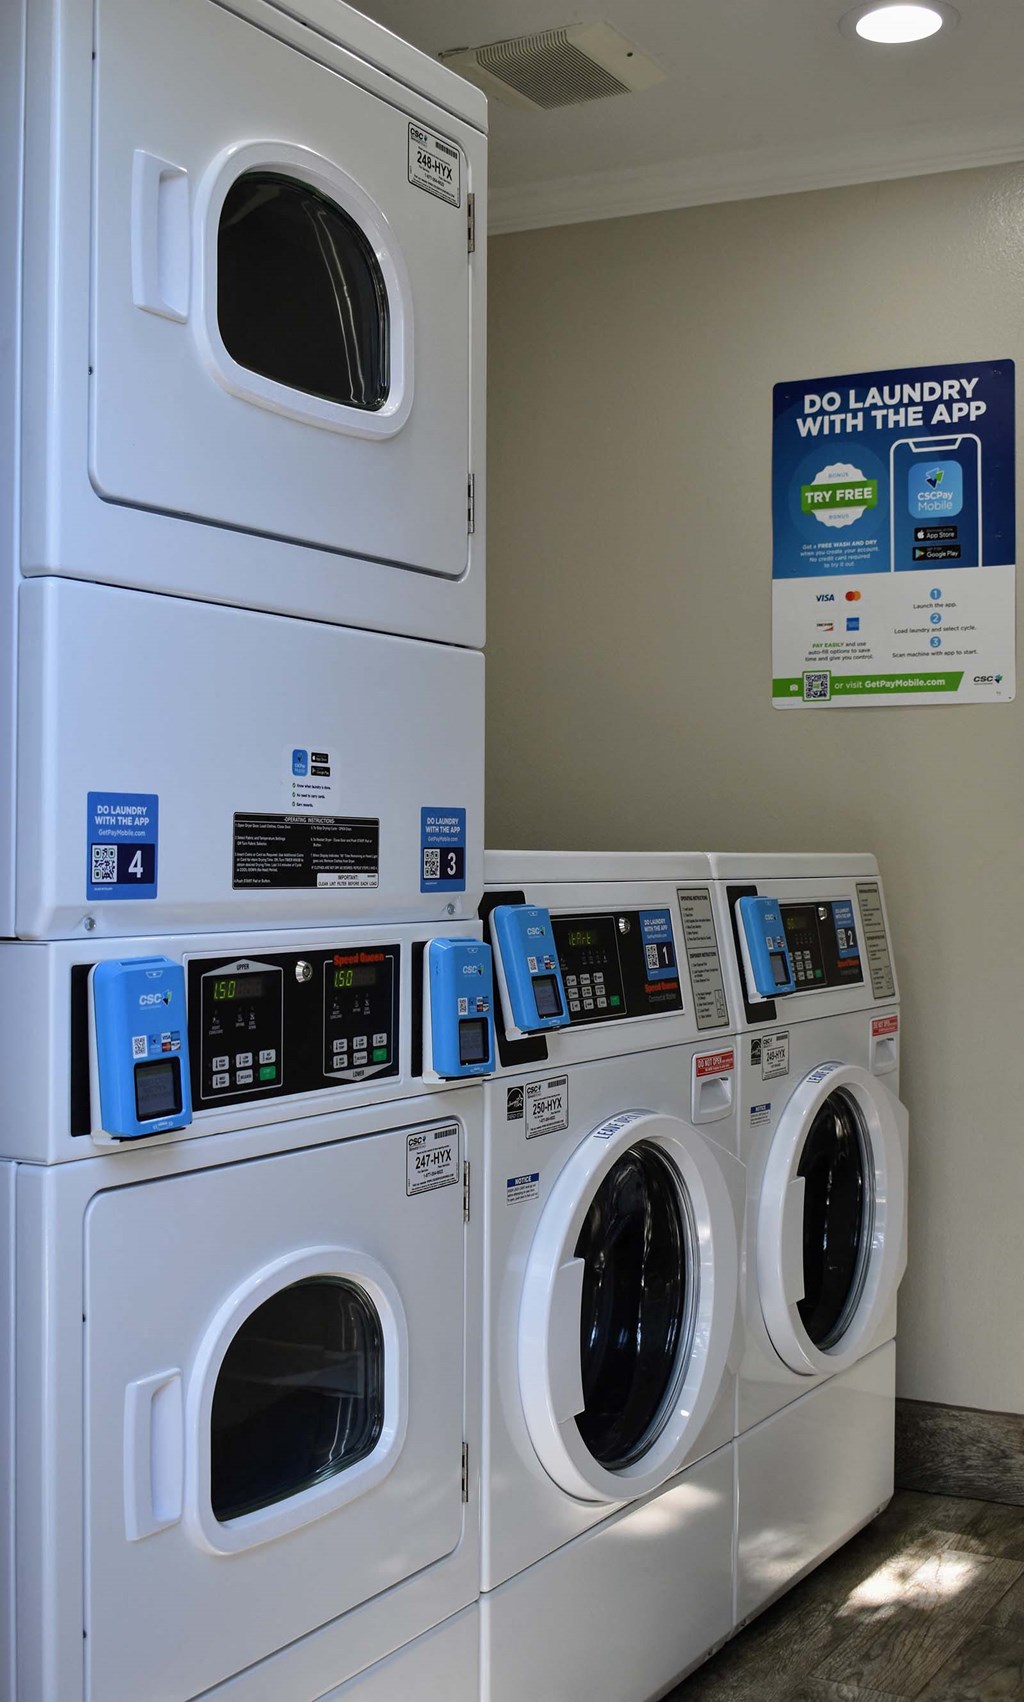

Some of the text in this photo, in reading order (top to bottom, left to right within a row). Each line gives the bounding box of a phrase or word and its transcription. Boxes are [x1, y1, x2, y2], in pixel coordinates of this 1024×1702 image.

[410, 128, 424, 140] CSC
[417, 151, 452, 180] 248-HYX
[804, 378, 979, 414] DO LAUNDRY
[796, 400, 986, 438] WITH THE APP
[805, 487, 872, 504] TRY FREE
[917, 491, 954, 500] CSCPay
[918, 502, 953, 511] Mobile
[864, 678, 946, 689] GetPayMobile.com
[97, 806, 147, 815] DO LAUNDRY
[95, 816, 150, 826] WITH THE APP
[98, 829, 146, 837] GetPayMobile.com
[128, 850, 143, 878] 4
[447, 852, 456, 875] 3
[848, 930, 854, 946] 2
[334, 953, 384, 966] Speed Queen
[662, 946, 668, 964] 1
[462, 966, 477, 974] CSC
[139, 993, 162, 1005] CSC
[527, 1085, 538, 1094] CSC
[533, 1097, 562, 1115] 250-HYX
[593, 1123, 624, 1139] LEAVE
[408, 1136, 422, 1146] CSC
[416, 1149, 452, 1169] 247-HYX
[515, 1176, 531, 1185] NOTICE
